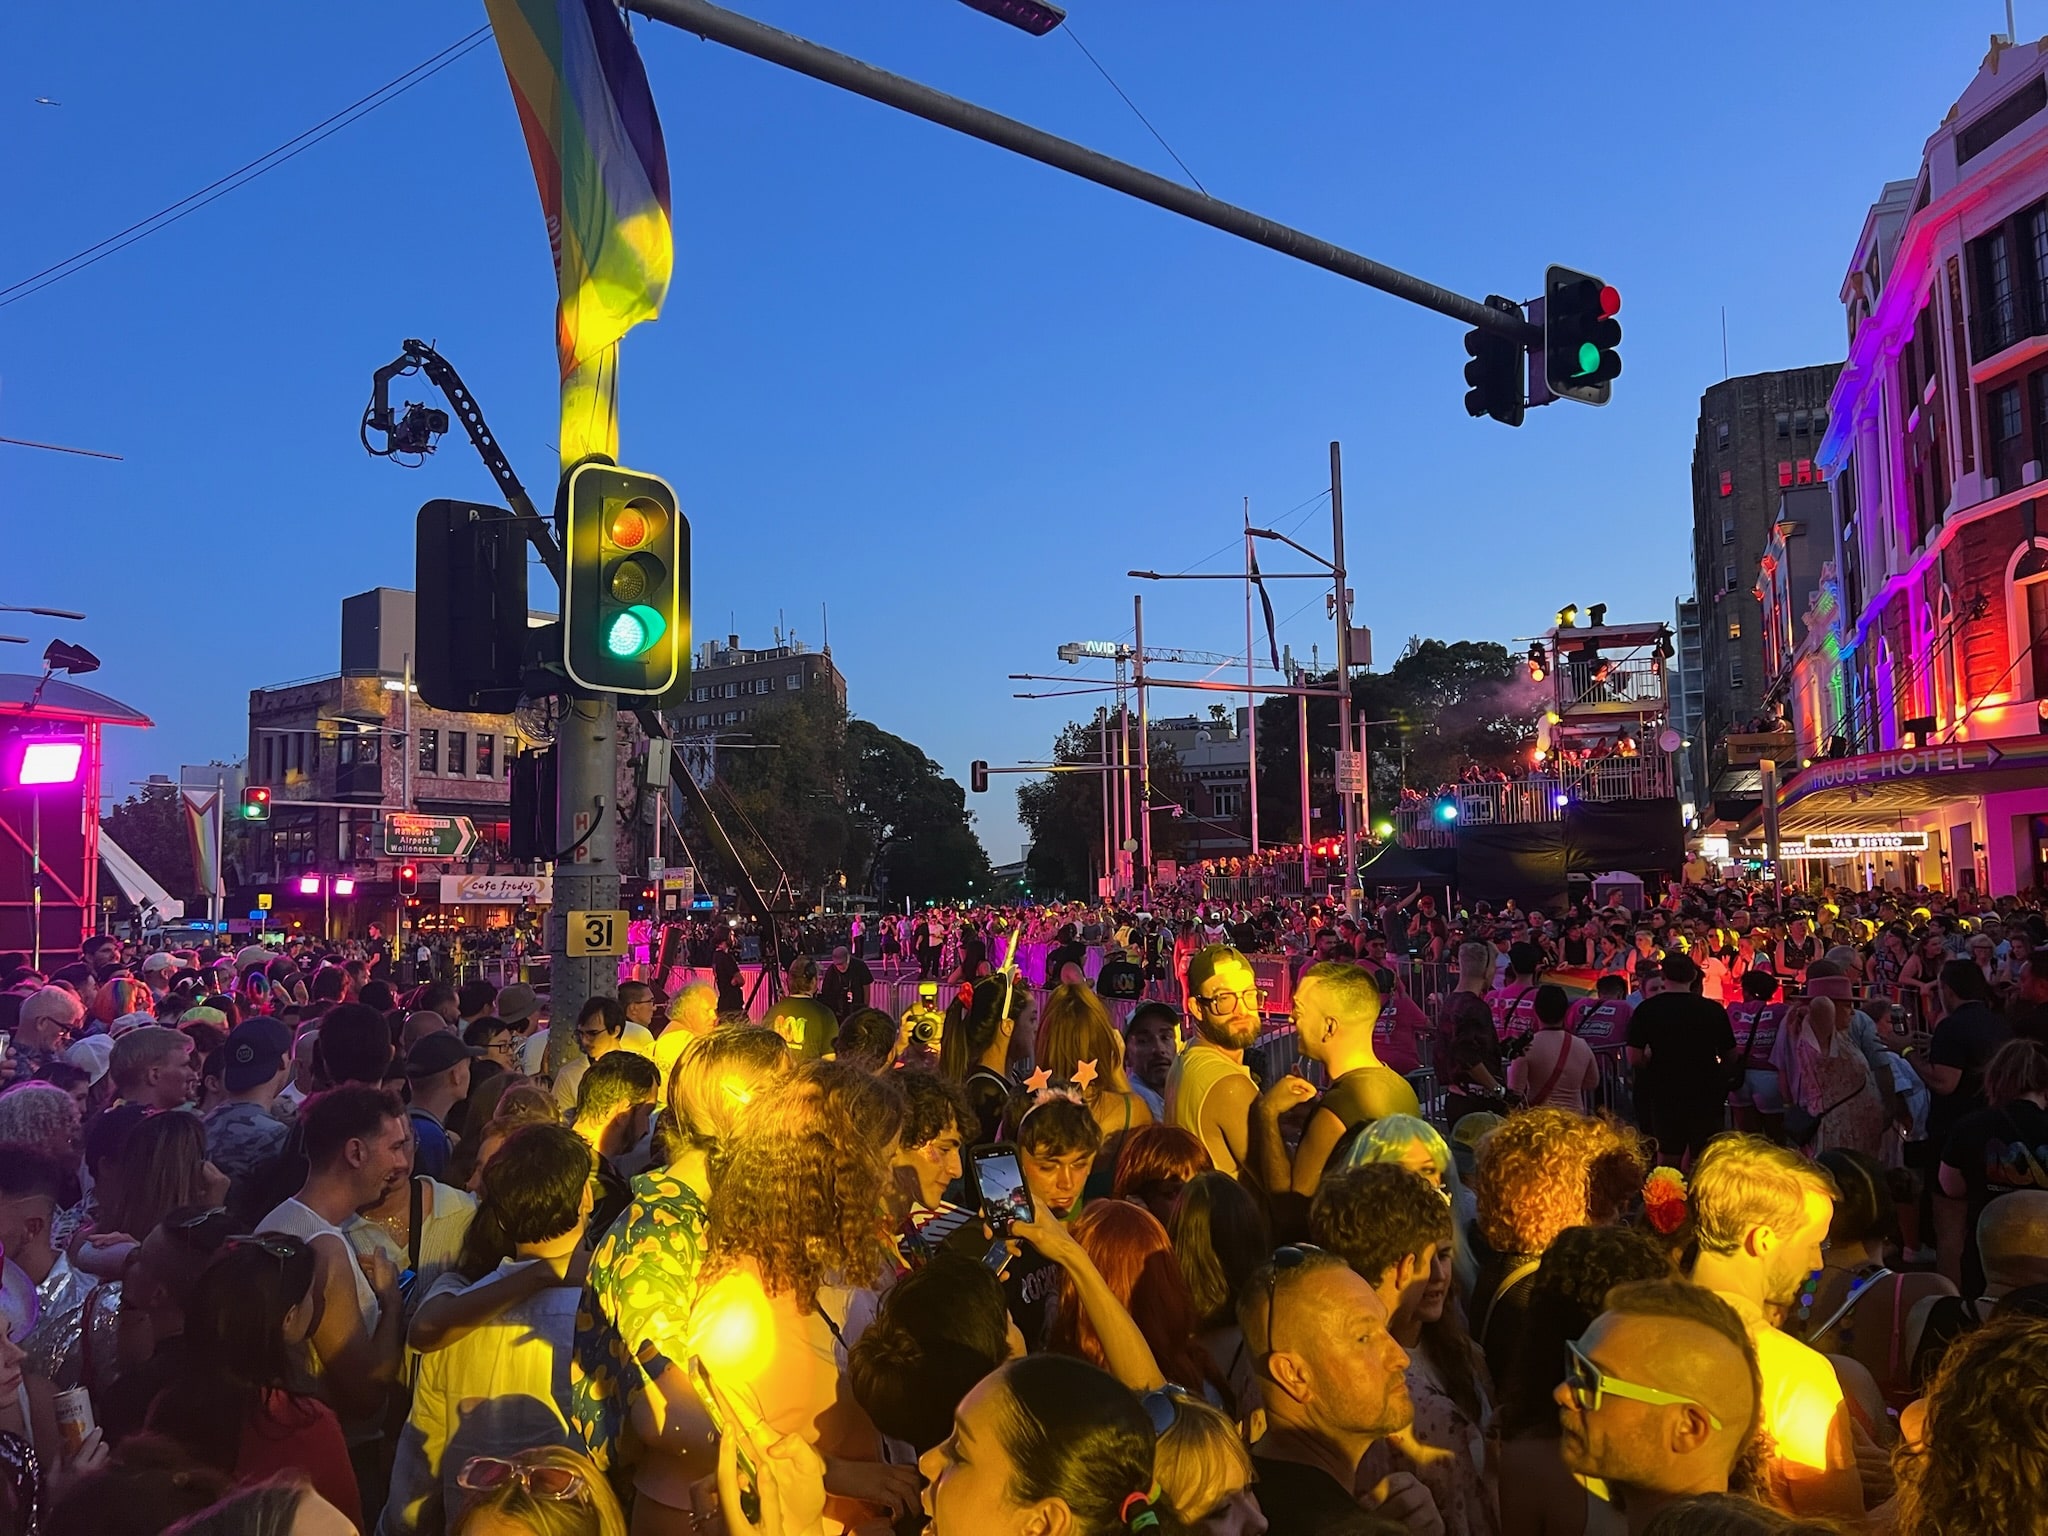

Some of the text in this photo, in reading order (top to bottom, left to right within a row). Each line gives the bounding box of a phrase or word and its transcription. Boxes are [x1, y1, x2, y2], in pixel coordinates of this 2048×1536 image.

[1086, 640, 1116, 654] AVID
[1881, 747, 1975, 777] HOTEL
[394, 827, 435, 837] Randwick
[400, 836, 430, 846] Airport
[1830, 837, 1903, 848] TAB BISTRO
[390, 844, 438, 855] Wollongong
[585, 919, 613, 948] 31
